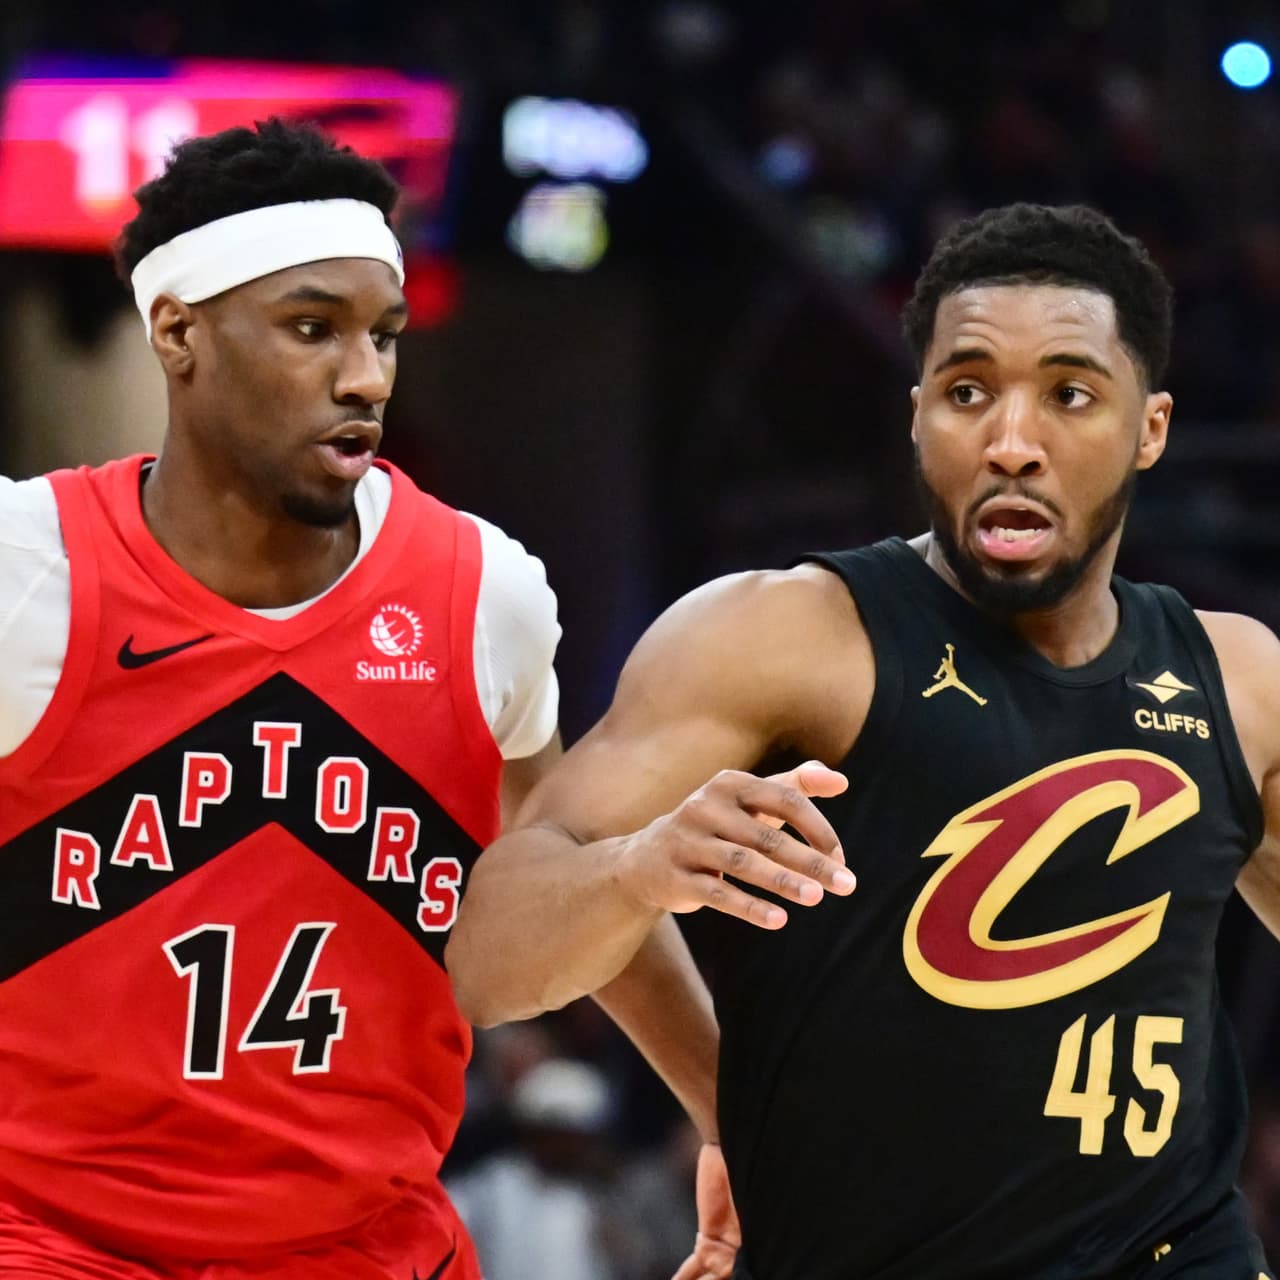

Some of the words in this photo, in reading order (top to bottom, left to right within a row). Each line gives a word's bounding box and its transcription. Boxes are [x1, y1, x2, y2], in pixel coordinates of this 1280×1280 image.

[356, 661, 396, 680] Sun
[400, 661, 436, 681] Life
[1135, 708, 1210, 739] CLIFFS
[52, 721, 462, 932] RAPTORS
[163, 922, 346, 1080] 14
[1044, 1014, 1184, 1157] 45
